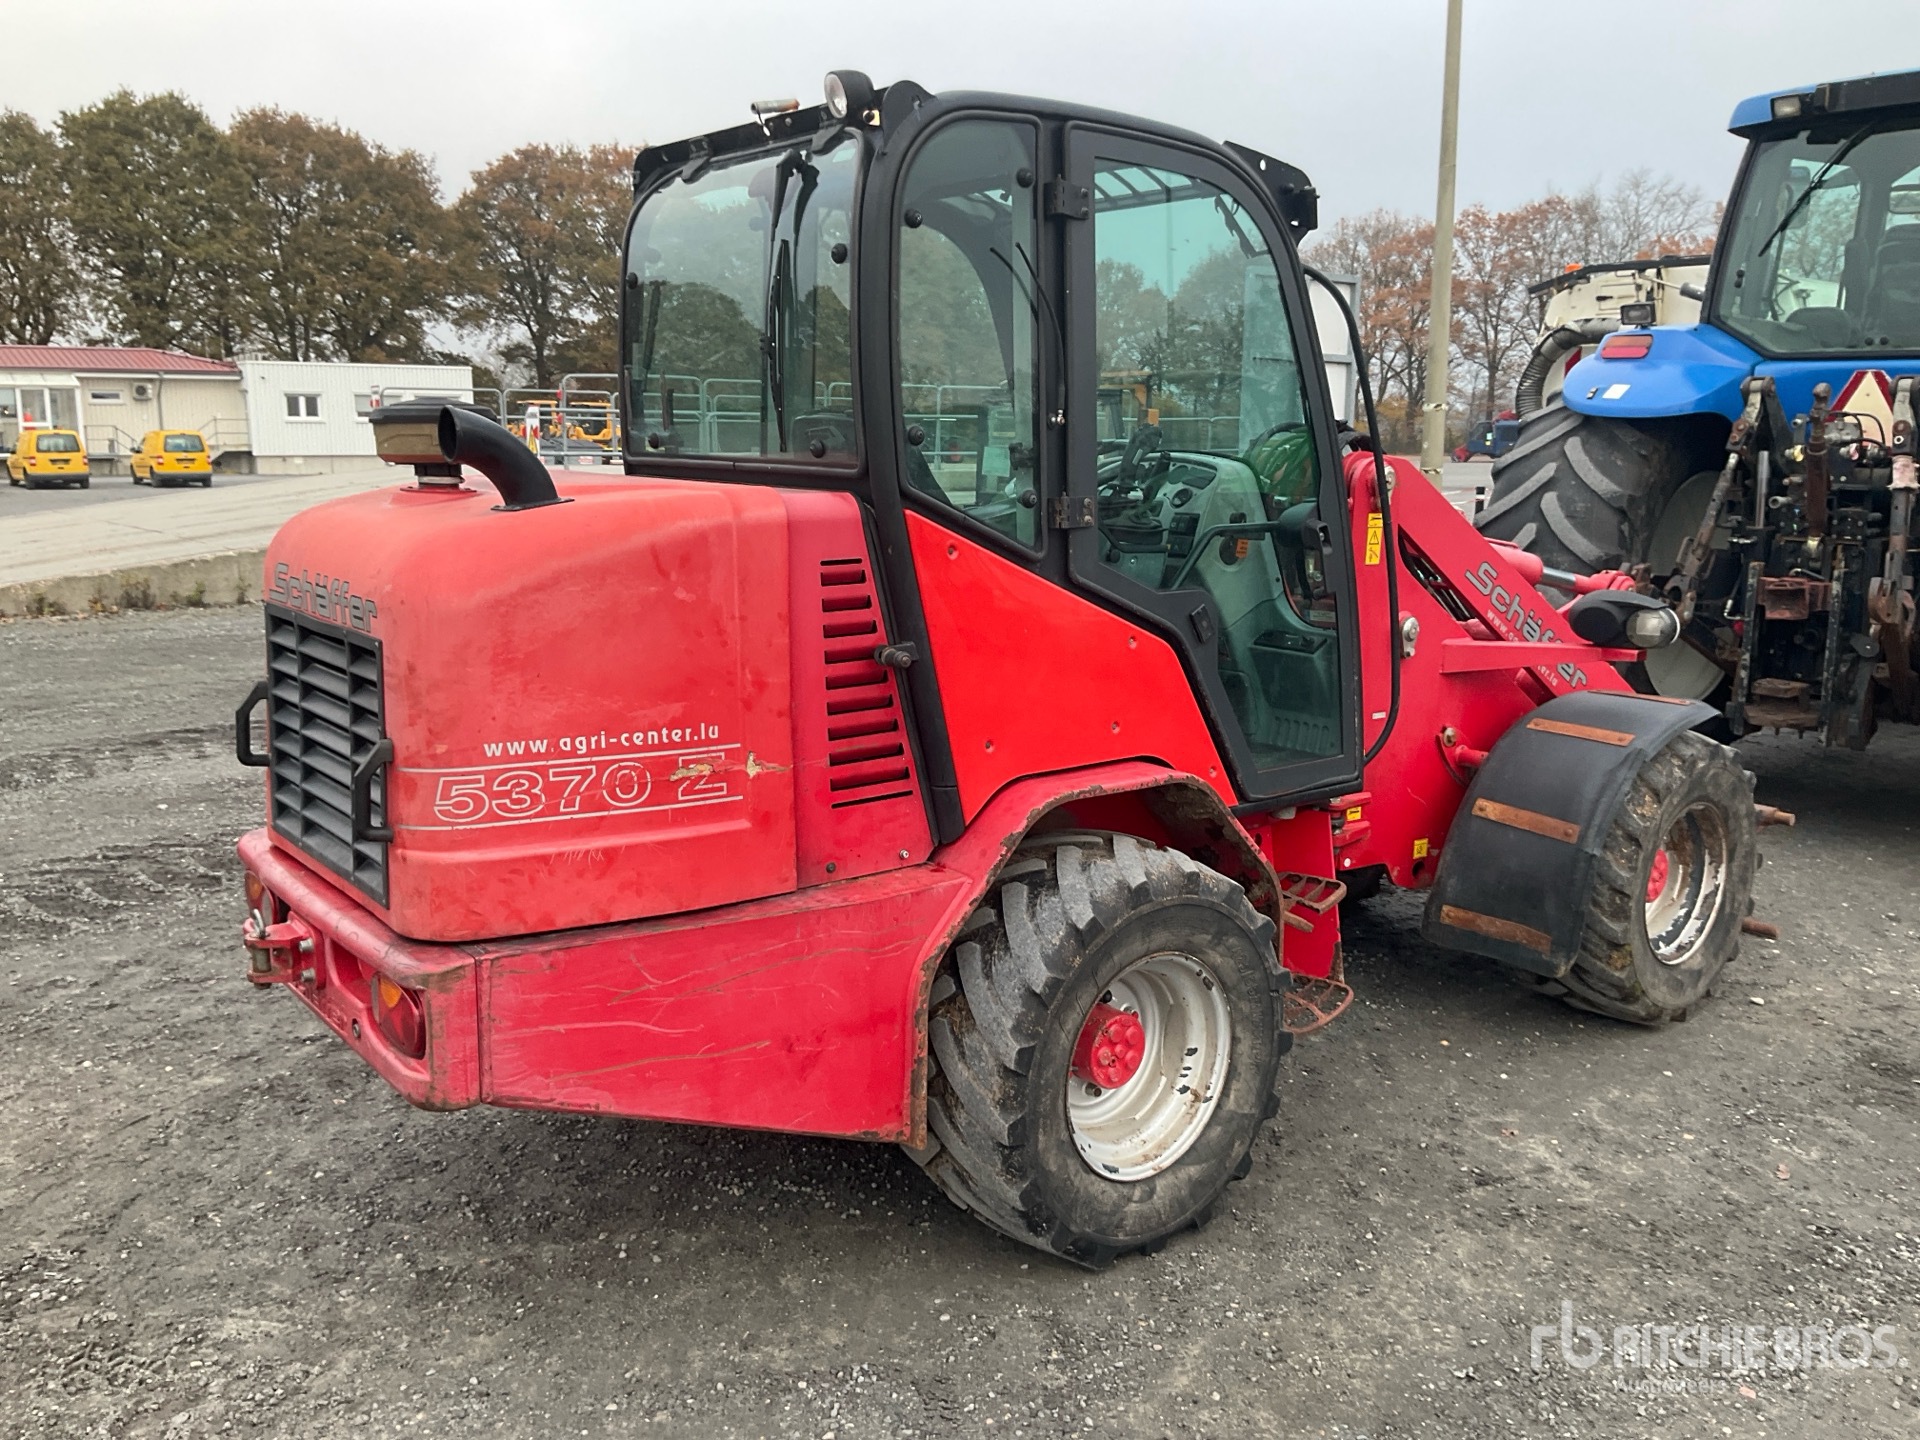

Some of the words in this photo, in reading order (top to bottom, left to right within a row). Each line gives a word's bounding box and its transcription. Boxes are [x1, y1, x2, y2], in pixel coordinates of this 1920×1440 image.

[269, 562, 377, 634] Schäffer
[483, 722, 719, 758] www.agri-center.lu
[434, 761, 651, 823] 5370
